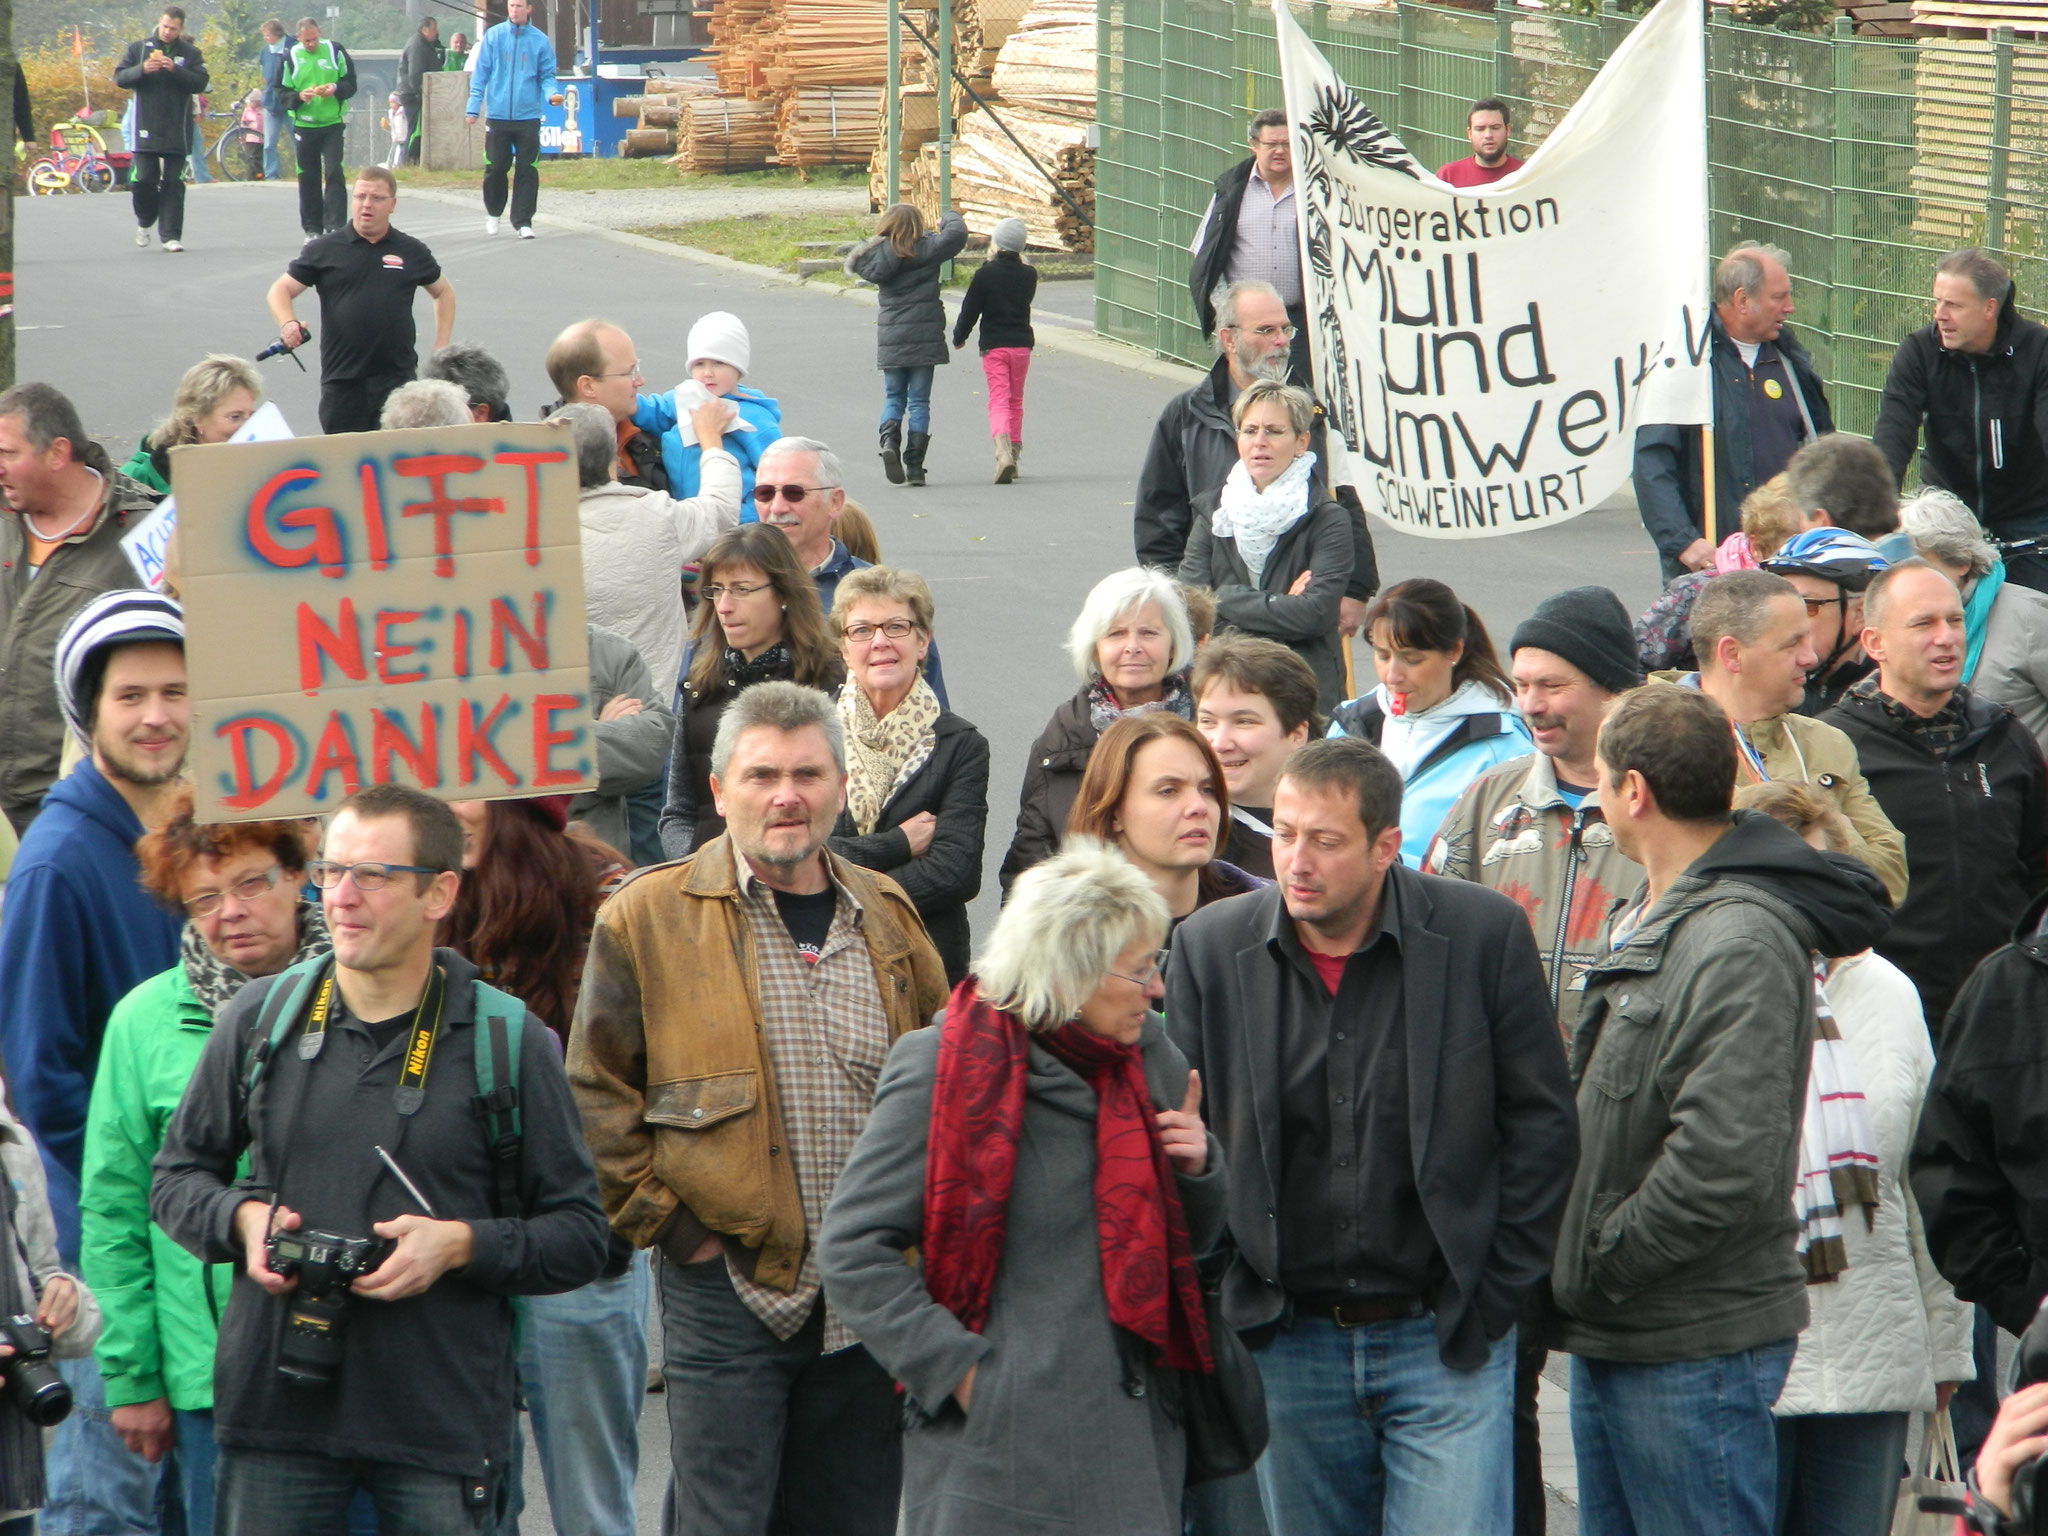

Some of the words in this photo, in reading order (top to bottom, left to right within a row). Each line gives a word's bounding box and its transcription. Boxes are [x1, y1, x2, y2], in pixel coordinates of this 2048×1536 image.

[1335, 177, 1559, 248] Bürgeraktion
[1341, 237, 1483, 327] Müll
[1380, 301, 1557, 396] und
[247, 451, 569, 578] GIFT
[297, 591, 551, 697] NEIN
[214, 693, 585, 811] DANKE
[311, 979, 334, 1022] Nikon
[407, 1029, 432, 1076] Nikon
